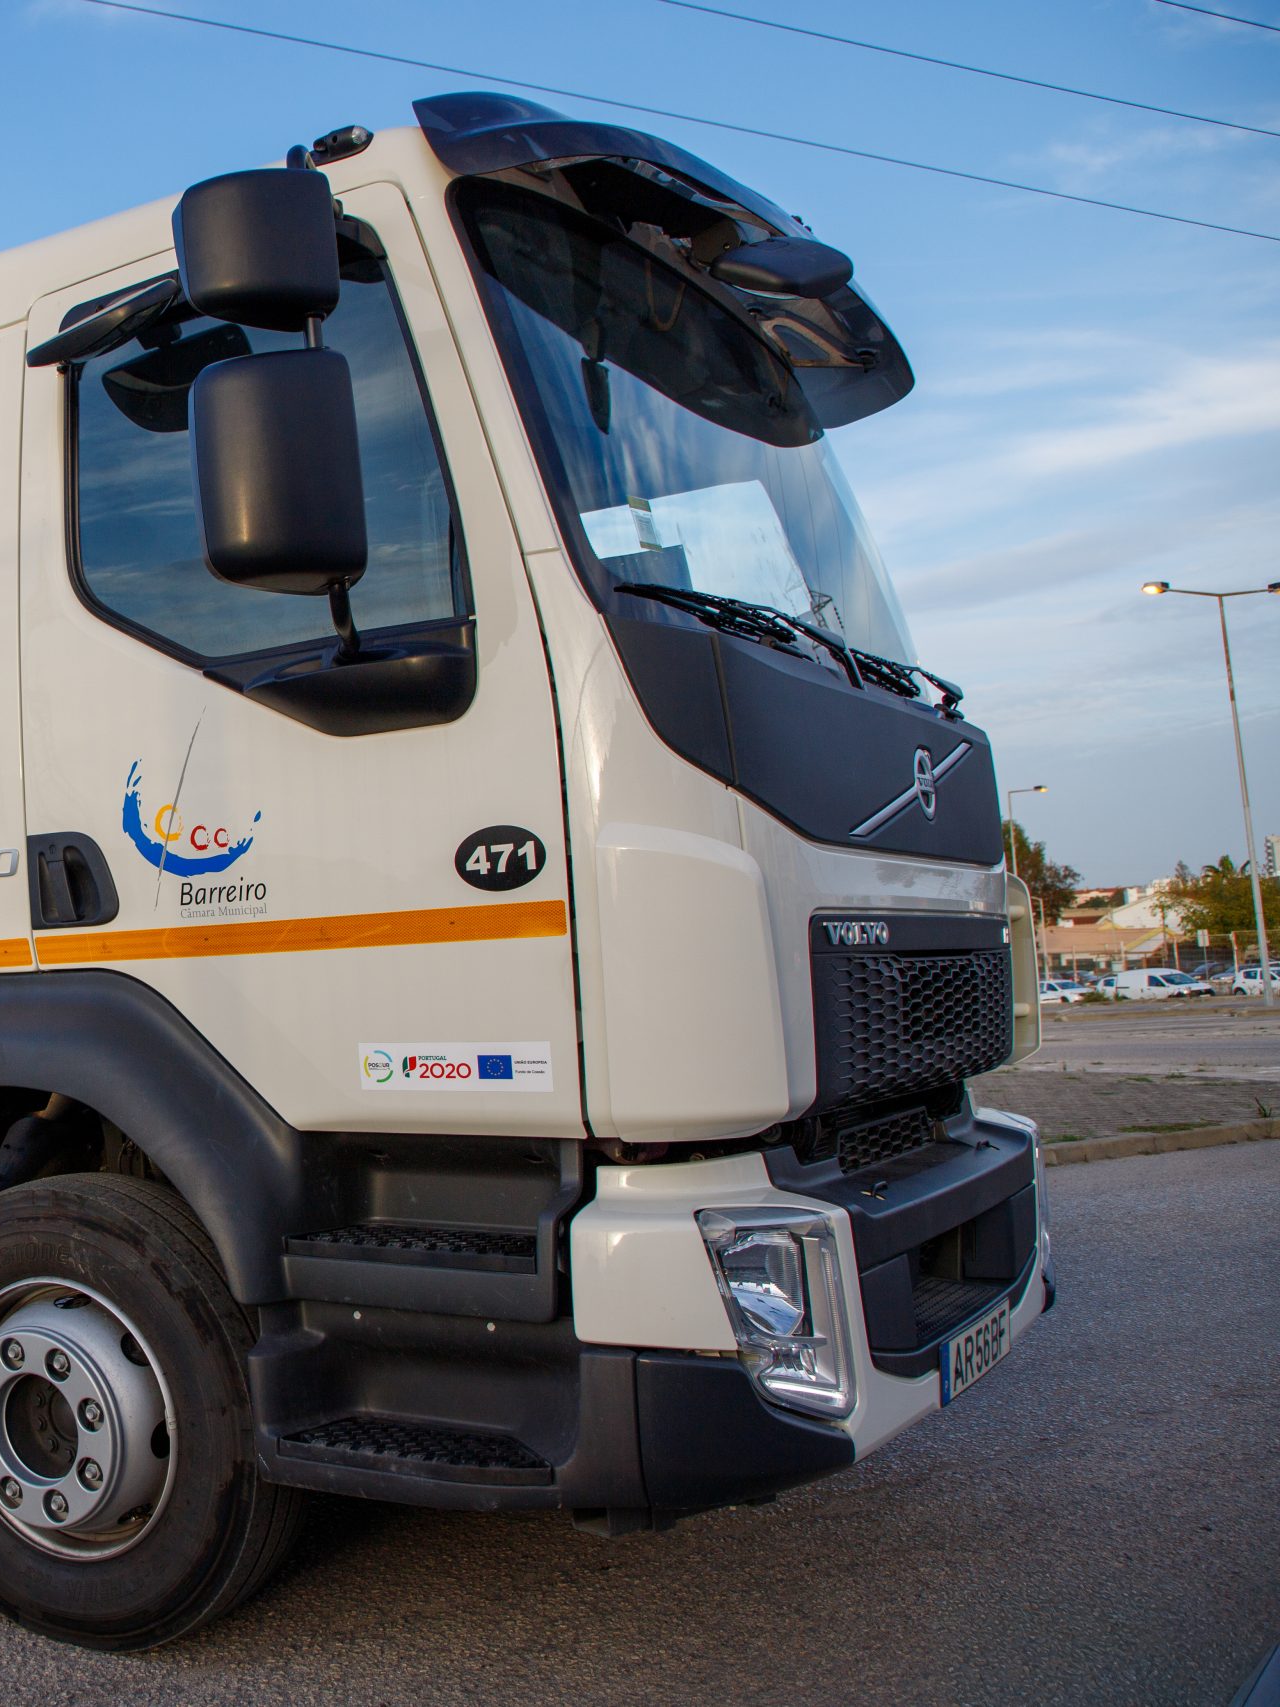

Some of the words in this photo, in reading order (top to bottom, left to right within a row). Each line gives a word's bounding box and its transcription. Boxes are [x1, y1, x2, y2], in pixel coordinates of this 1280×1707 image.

[466, 840, 537, 875] 471
[180, 876, 267, 906] Barreiro
[180, 907, 215, 919] Câmara
[218, 903, 268, 918] Municipal
[823, 921, 889, 946] VOLVO
[419, 1062, 472, 1079] 2020
